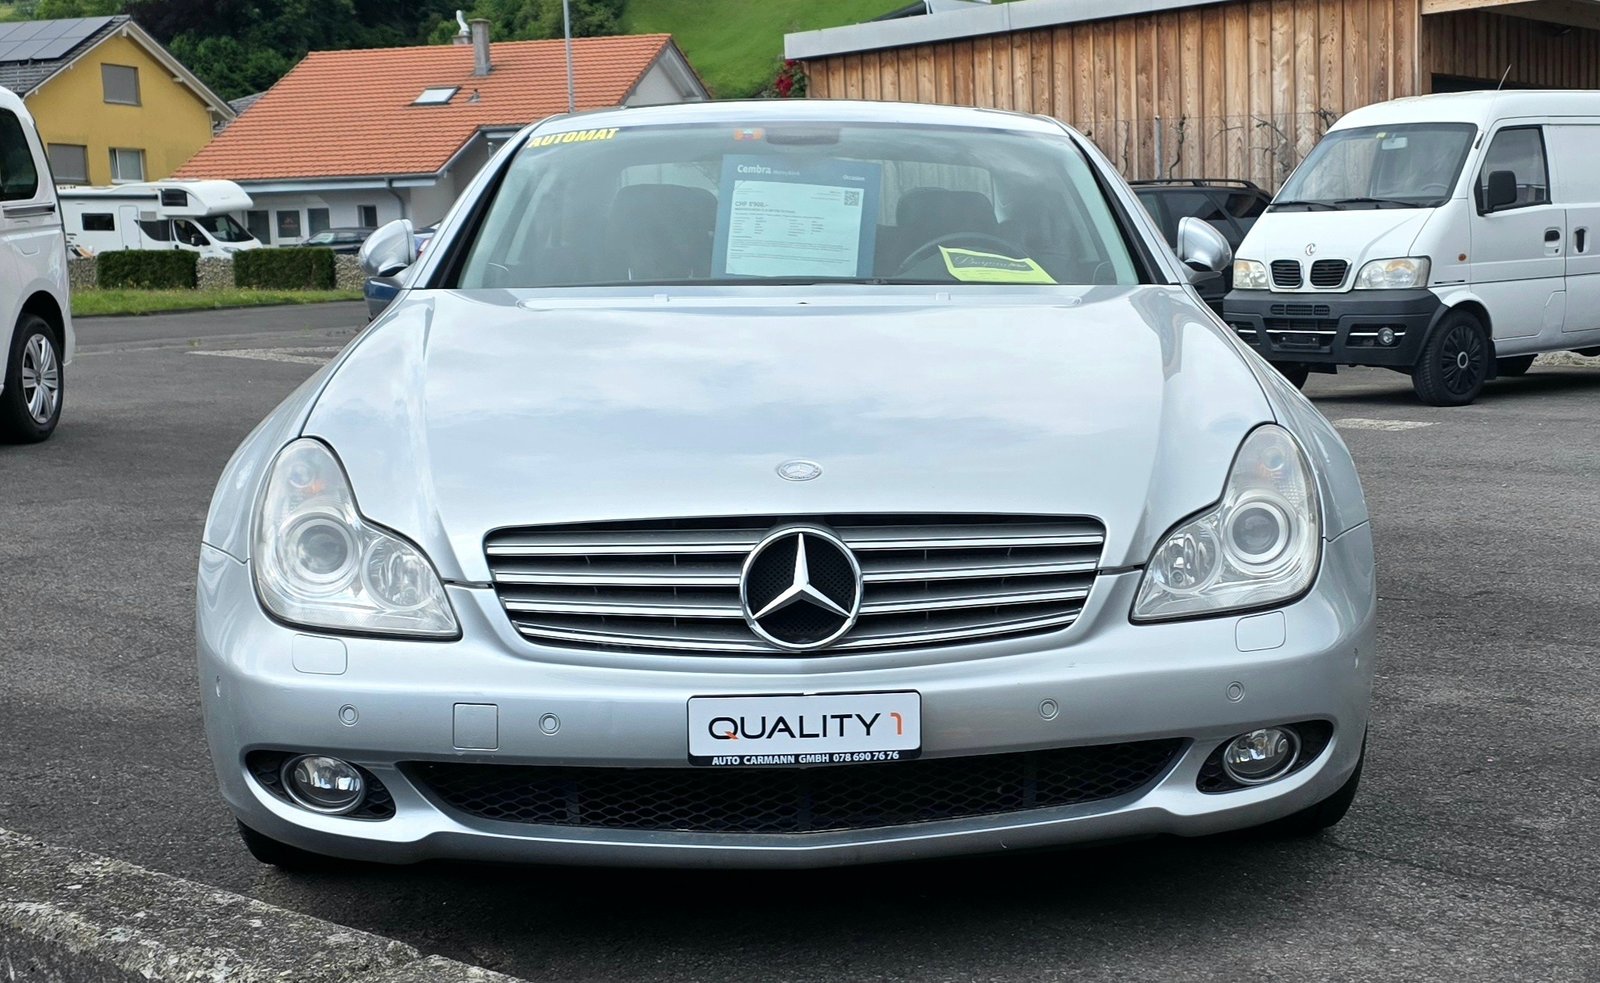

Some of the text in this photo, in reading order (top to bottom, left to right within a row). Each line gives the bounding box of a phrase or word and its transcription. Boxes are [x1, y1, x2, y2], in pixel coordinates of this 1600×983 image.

[527, 128, 619, 148] AUTOMAT
[737, 164, 771, 174] Cembra
[708, 712, 903, 740] QUALITY 1
[712, 751, 899, 765] AUTO CARMANN GMBH 078 690 76 76
